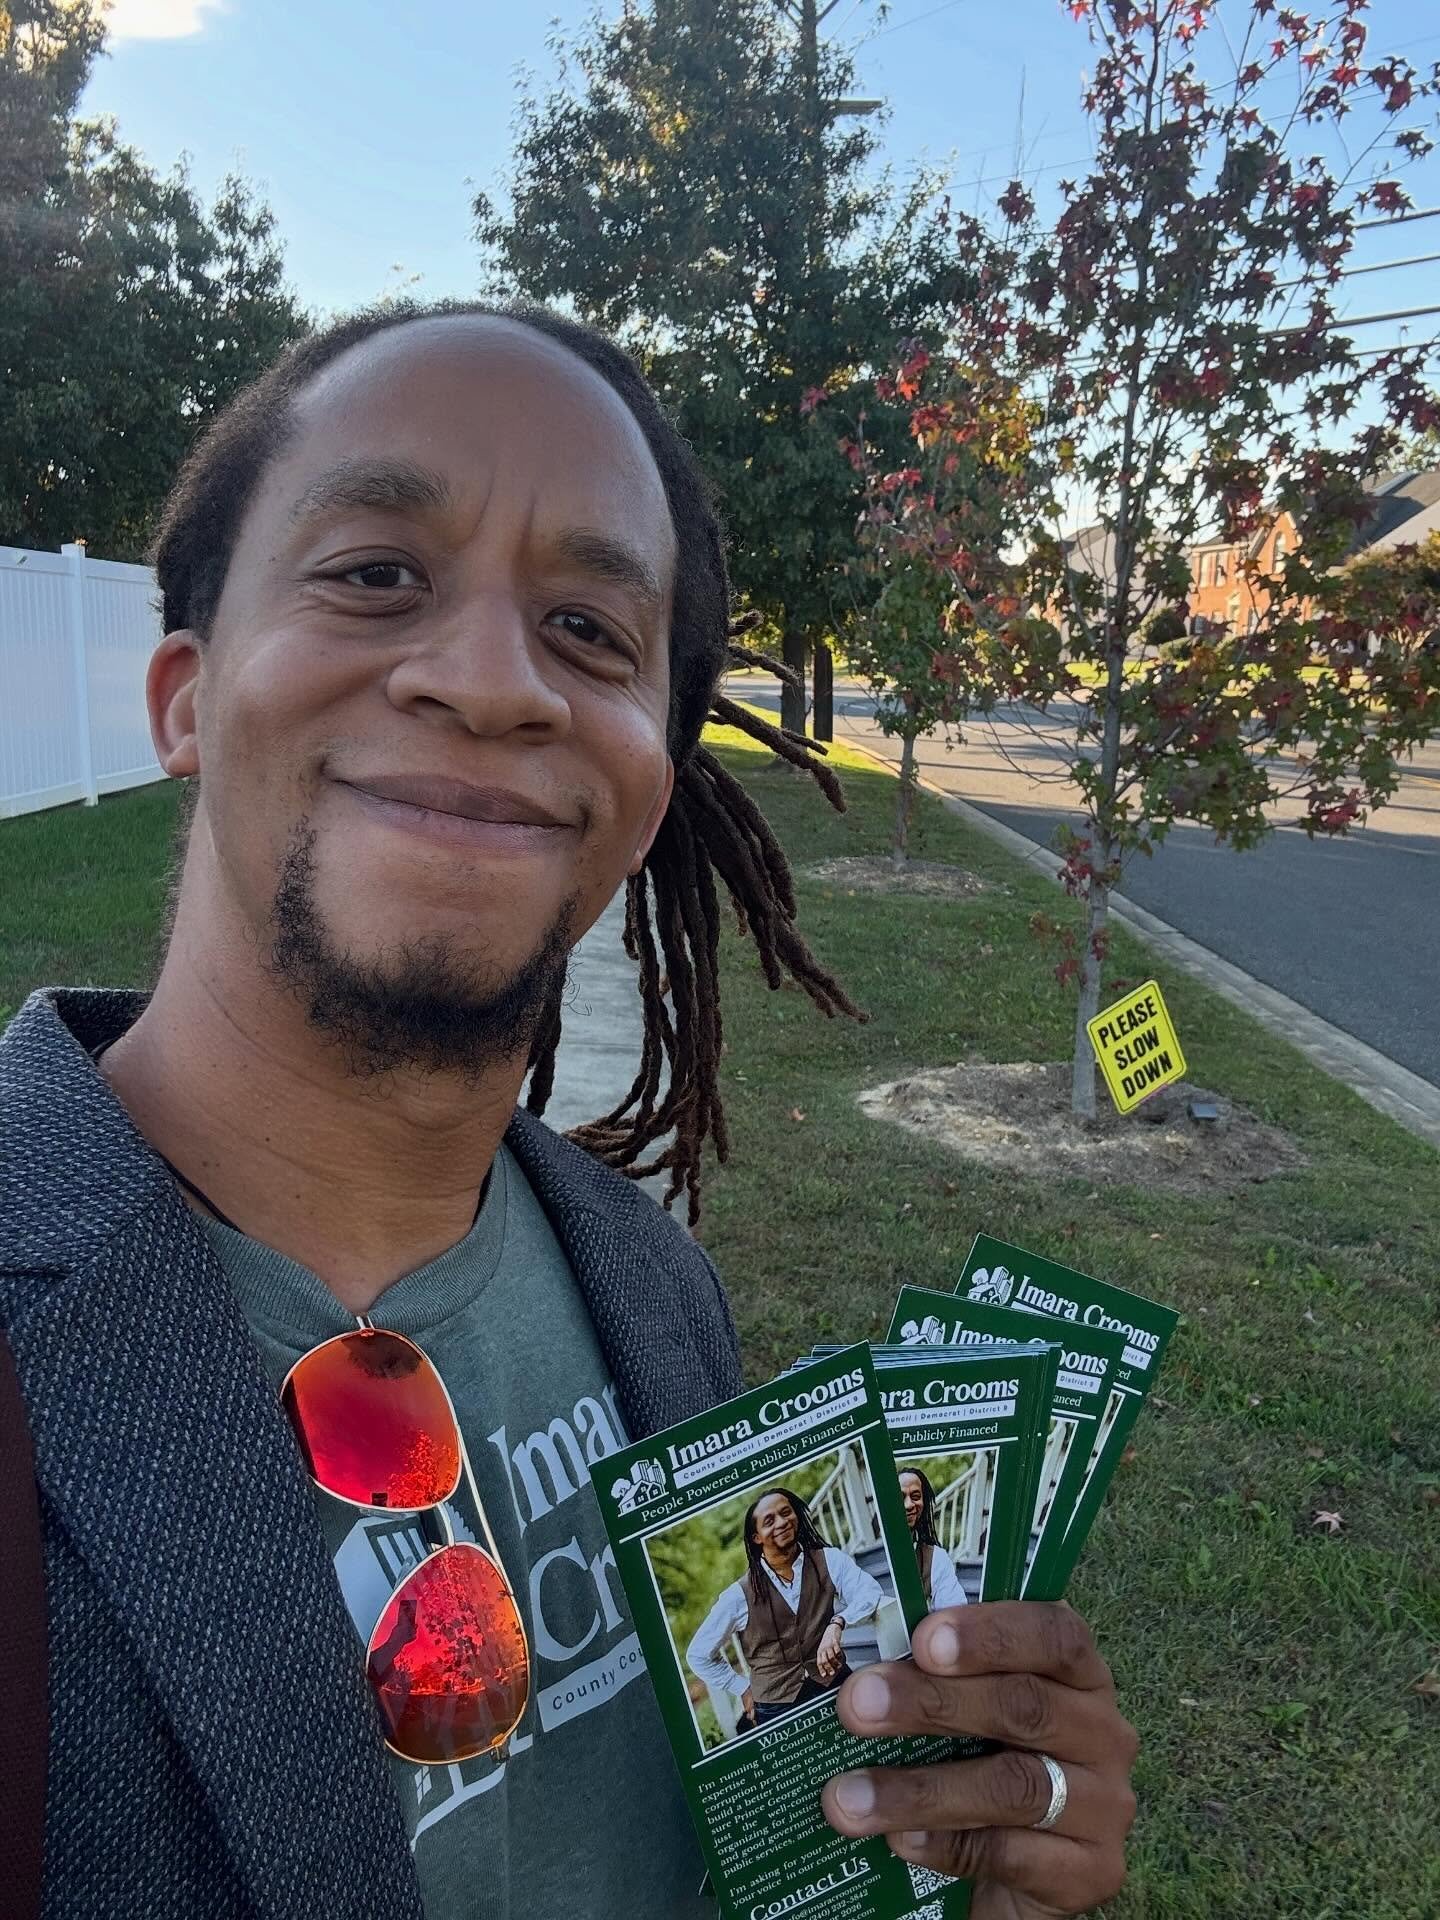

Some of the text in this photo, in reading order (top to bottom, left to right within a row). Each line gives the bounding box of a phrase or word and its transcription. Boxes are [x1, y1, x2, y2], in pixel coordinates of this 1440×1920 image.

[1098, 996, 1157, 1048] PLEASE
[1114, 1025, 1160, 1070] SLOW
[1122, 1051, 1173, 1099] DOWN
[1015, 1275, 1160, 1352] Imara Crooms
[666, 1367, 866, 1471] Imara Crooms
[886, 1415, 912, 1423] ouncil
[921, 1410, 961, 1420] Democrat
[970, 1406, 1000, 1415] District
[923, 1379, 1020, 1405] Crooms
[1053, 1395, 1083, 1407] anced
[487, 1383, 630, 1539] Imar
[683, 1461, 716, 1480] County
[719, 1443, 755, 1463] Council
[764, 1419, 808, 1443] Democrat
[816, 1398, 851, 1419] District
[902, 1429, 946, 1443] Publicly
[949, 1422, 999, 1438] Financed
[640, 1493, 683, 1522] People
[686, 1468, 740, 1504] Powered
[750, 1442, 799, 1472] Publicly
[801, 1415, 855, 1448] Financed
[528, 1535, 625, 1662] Cr
[552, 1667, 615, 1711] County
[698, 1720, 839, 1793] I'm running for County Cou
[757, 1727, 791, 1748] Why
[793, 1715, 816, 1731] I'm
[702, 1778, 745, 1803] expertise
[754, 1769, 764, 1778] in
[834, 1729, 846, 1740] go
[704, 1785, 756, 1814] corruption
[759, 1763, 801, 1789] practices
[804, 1757, 814, 1765] to
[816, 1742, 840, 1758] work
[707, 1806, 733, 1824] build
[744, 1788, 773, 1806] better
[776, 1772, 804, 1791] future
[808, 1764, 822, 1775] for
[825, 1755, 840, 1766] my
[711, 1821, 731, 1834] sure
[734, 1804, 764, 1824] Prince
[767, 1783, 808, 1806] George's
[810, 1764, 844, 1784] County
[847, 1750, 874, 1767] works
[877, 1742, 890, 1753] for
[714, 1832, 732, 1848] just
[742, 1820, 757, 1831] the
[767, 1788, 823, 1818] well-connec
[717, 1826, 769, 1855] organizing
[771, 1817, 785, 1828] for
[721, 1851, 738, 1866] and
[741, 1838, 765, 1857] good
[768, 1812, 820, 1844] governance
[723, 1857, 753, 1878] public
[797, 1825, 814, 1840] and
[730, 1885, 746, 1897] I'm
[750, 1868, 780, 1887] asking
[783, 1860, 796, 1870] for
[800, 1846, 822, 1863] your
[732, 1892, 755, 1909] your
[756, 1879, 781, 1894] voice
[786, 1872, 796, 1880] in
[798, 1862, 814, 1874] our
[816, 1845, 847, 1865] county
[750, 1857, 870, 1920] Contact Us
[789, 1873, 881, 1920] fo@imaracrooms.com
